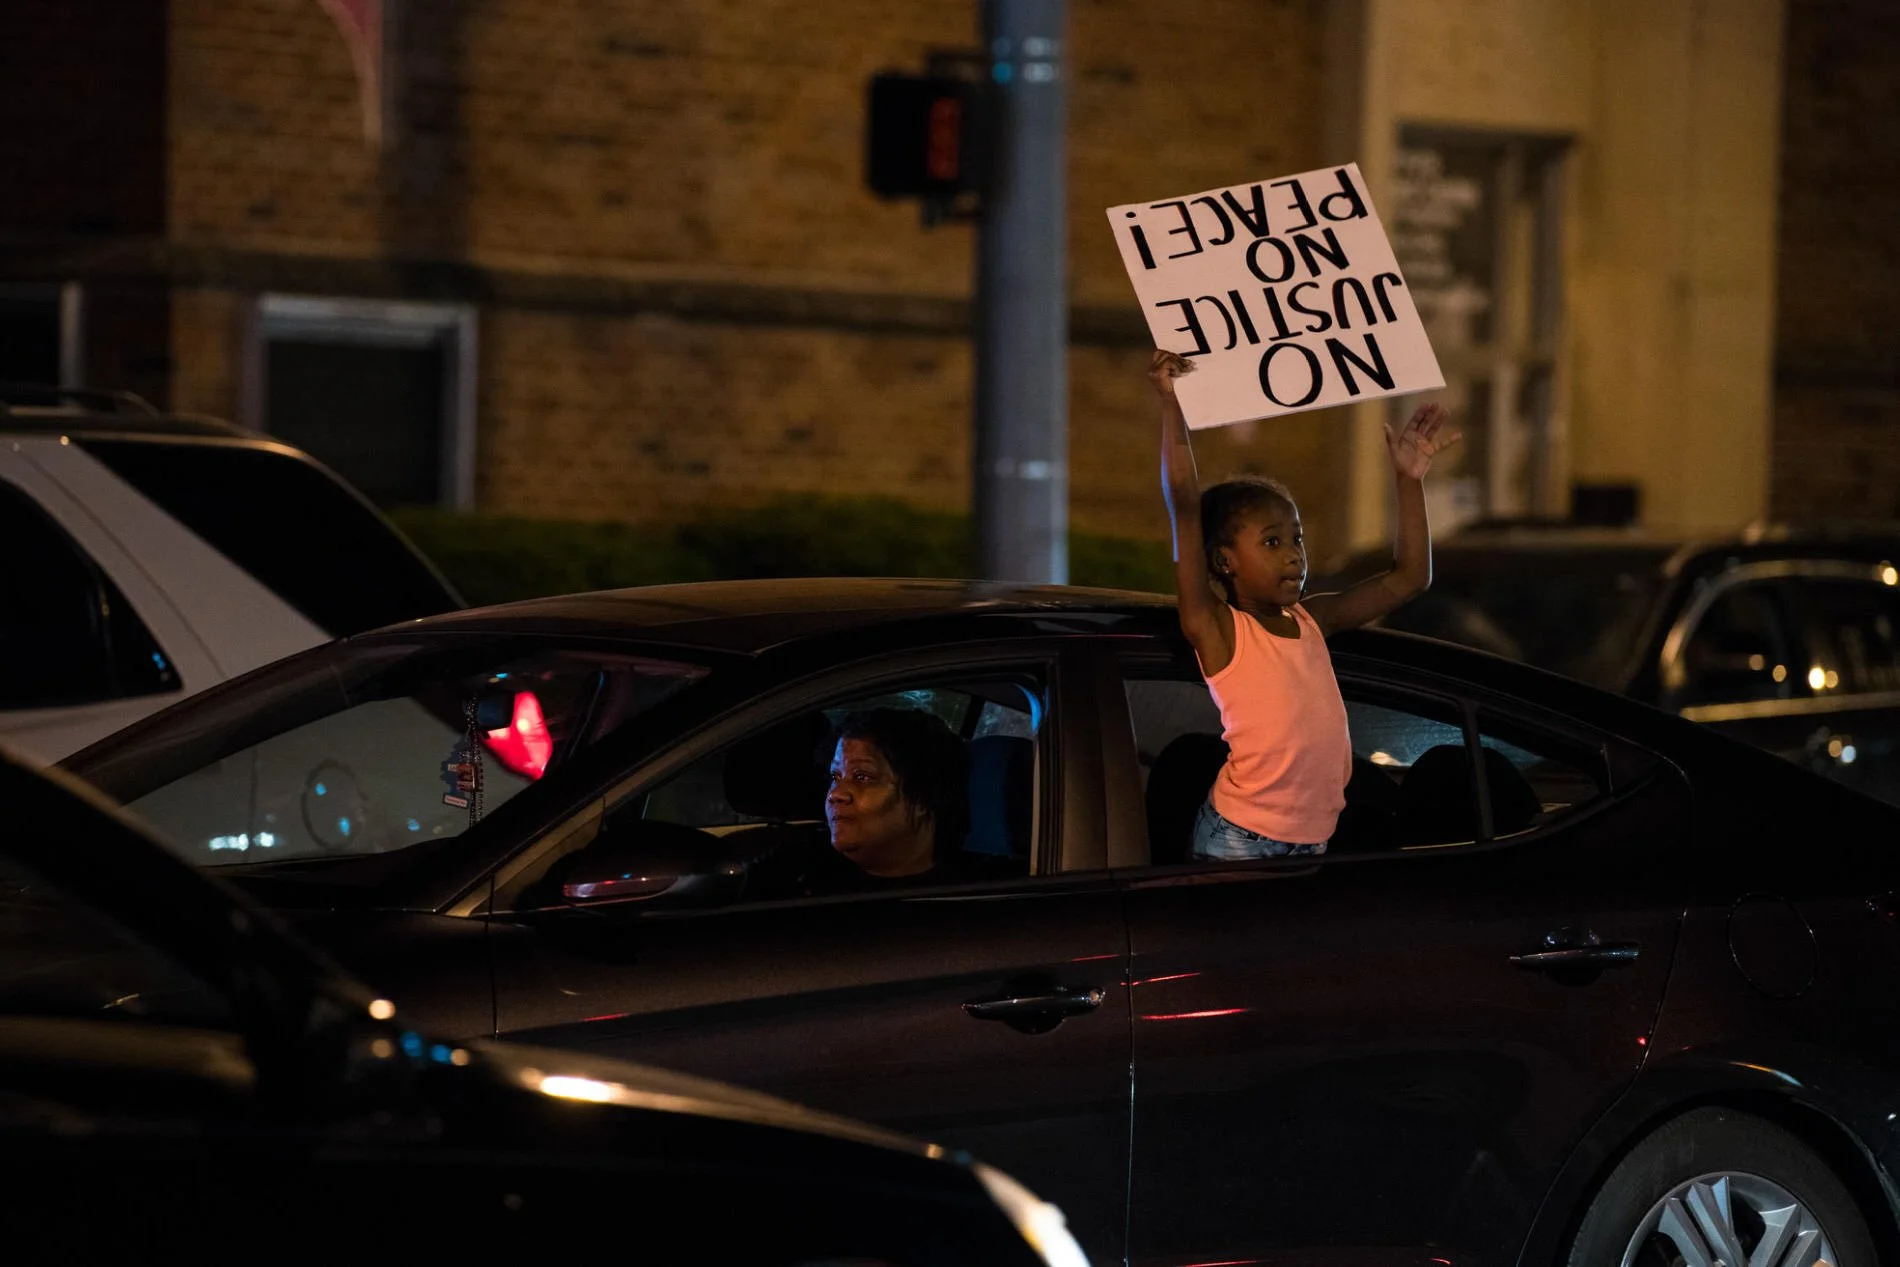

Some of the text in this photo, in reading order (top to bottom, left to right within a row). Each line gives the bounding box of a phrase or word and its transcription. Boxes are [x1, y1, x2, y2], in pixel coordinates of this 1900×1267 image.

[1125, 169, 1368, 269] PEACE!
[1246, 228, 1350, 283] NO
[1156, 273, 1402, 358] JUSTICE
[1259, 333, 1395, 407] NO
